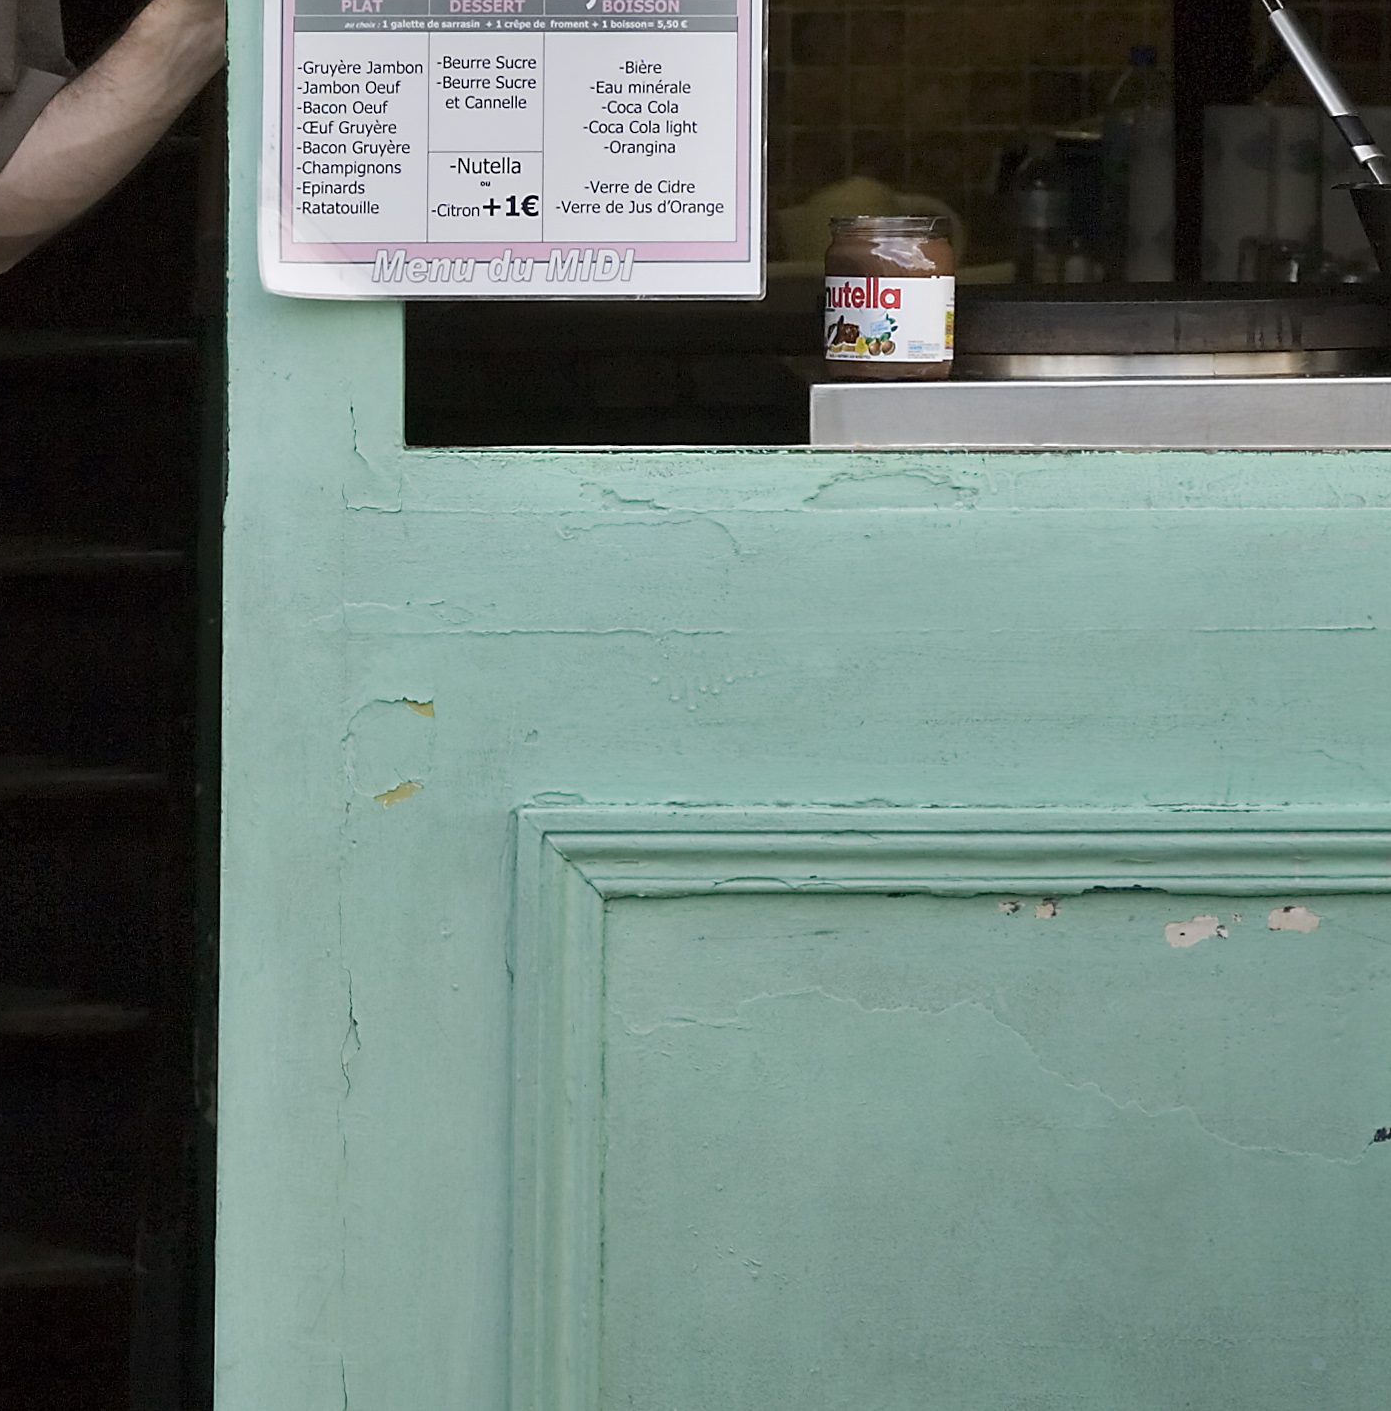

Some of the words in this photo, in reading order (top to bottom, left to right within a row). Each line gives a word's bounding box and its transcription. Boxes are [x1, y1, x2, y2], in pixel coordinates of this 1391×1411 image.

[341, 0, 384, 13] PLAT
[449, 0, 526, 13] DESSERT
[601, 0, 680, 13] BOISSON
[382, 20, 389, 29] 1
[390, 20, 425, 31] galette
[427, 20, 440, 29] de
[441, 20, 480, 29] sarrasin
[504, 20, 531, 31] crêpe
[533, 20, 546, 29] de
[550, 20, 589, 29] froment
[657, 20, 679, 31] 5,50
[297, 59, 362, 77] -Gruyère
[366, 60, 424, 75] Jambon
[436, 55, 491, 70] -Beurre
[495, 55, 537, 70] Sucre
[618, 59, 663, 75] -Bière
[297, 80, 360, 95] -Jambon
[365, 80, 402, 95] Oeuf
[436, 75, 491, 90] -Beurre
[495, 75, 537, 90] Sucre
[589, 80, 623, 95] -Eau
[628, 79, 692, 95] minérale
[296, 100, 347, 115] -Bacon
[352, 100, 389, 115] Oeuf
[445, 96, 460, 110] et
[464, 95, 528, 110] Cannelle
[601, 100, 643, 115] -Coca
[647, 100, 679, 114] Cola
[338, 119, 397, 138] Gruyère
[582, 120, 624, 135] -Coca
[628, 120, 661, 134] Cola
[665, 120, 698, 137] light
[296, 140, 347, 155] -Bacon
[352, 139, 411, 157] Gruyère
[603, 140, 676, 157] -Orangina
[296, 160, 402, 178] -Champignons
[449, 156, 522, 175] -Nutella
[295, 180, 366, 198] -Epinards
[583, 180, 630, 195] -Verre
[634, 180, 653, 194] de
[657, 180, 696, 194] Cidre
[295, 201, 380, 215] -Ratatouille
[431, 203, 480, 218] -Citron
[555, 200, 601, 215] -Verre
[605, 200, 624, 214] de
[628, 200, 653, 214] Jus
[657, 200, 725, 217] d'Orange
[371, 249, 476, 283] Menu
[487, 249, 535, 282] du
[545, 248, 636, 282] MIDI
